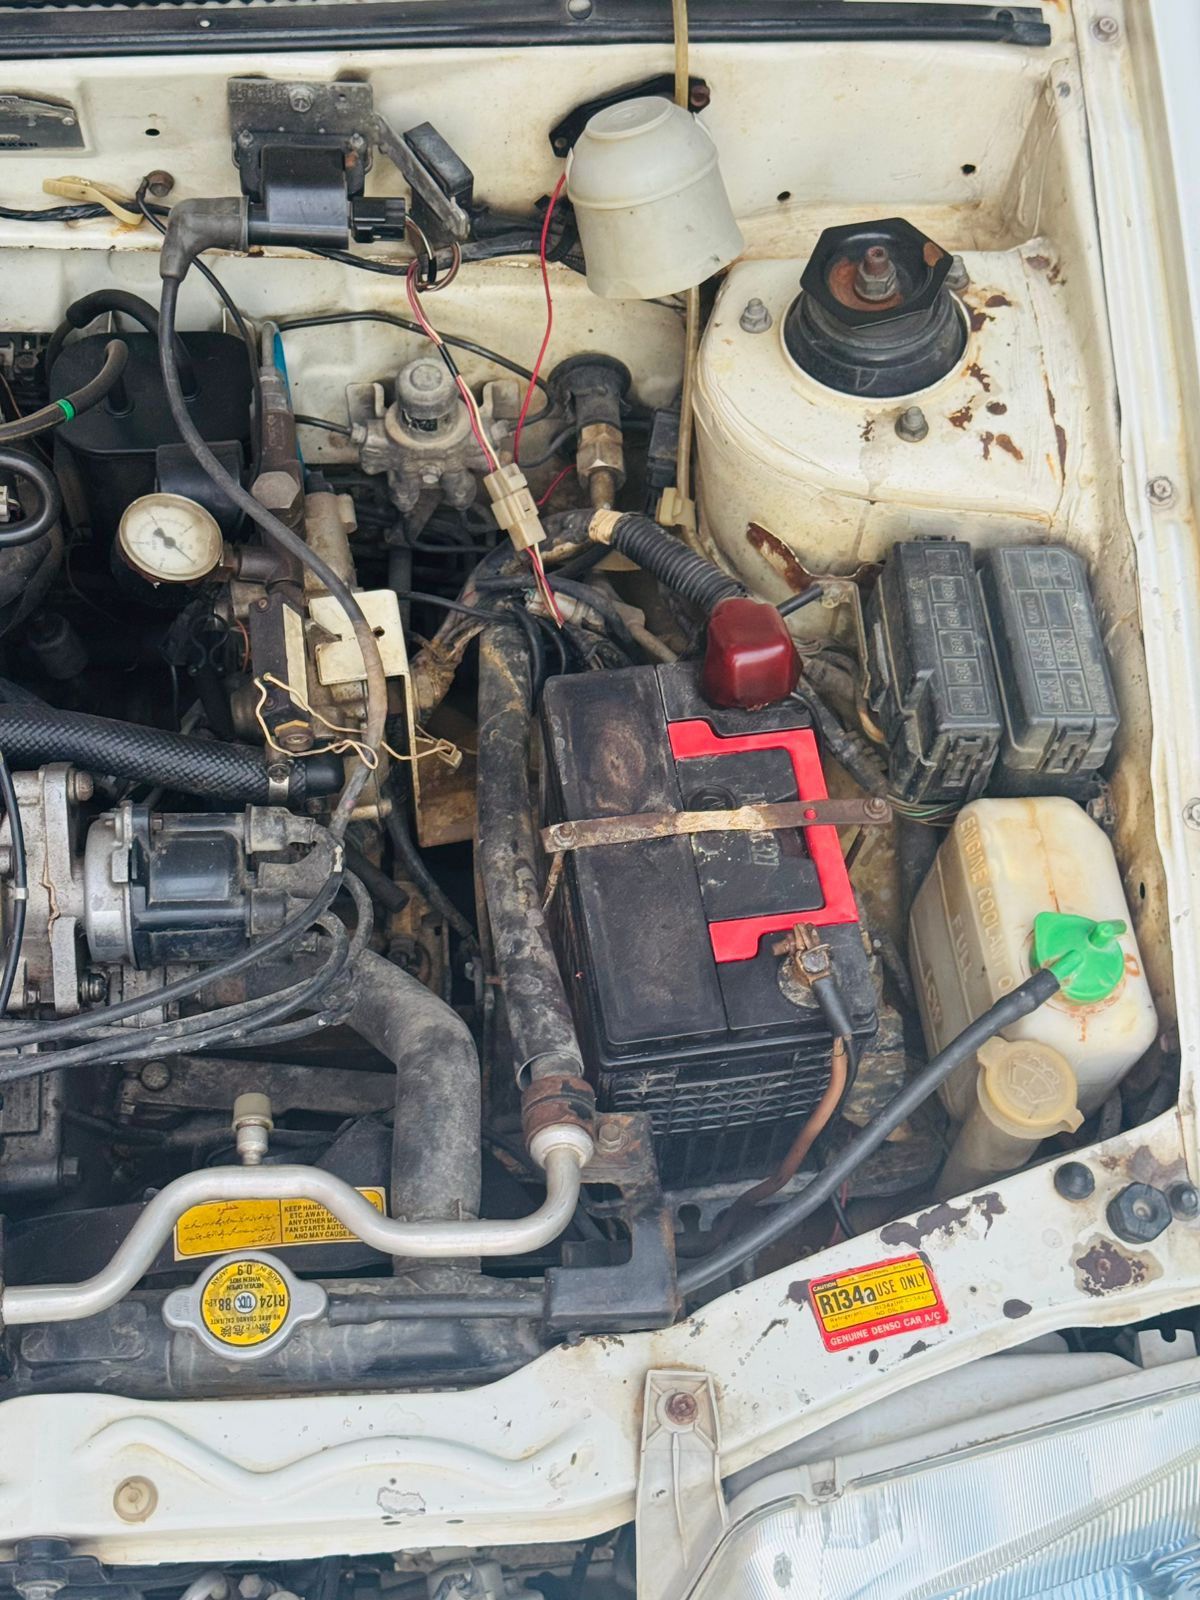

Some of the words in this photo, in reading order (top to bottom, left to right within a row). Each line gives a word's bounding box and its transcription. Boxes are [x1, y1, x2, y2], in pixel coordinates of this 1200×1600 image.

[960, 816, 989, 883] ENGINE
[976, 888, 1009, 968] COOLANT
[952, 914, 974, 982] FULL
[303, 1217, 326, 1225] OTHER
[325, 1230, 347, 1238] CAUSE
[211, 1268, 228, 1286] JAPAN
[237, 1264, 253, 1275] 0.9
[267, 1268, 282, 1286] MADE
[812, 1282, 837, 1292] CAUTION
[818, 1285, 877, 1315] R134a
[875, 1279, 897, 1297] USE
[900, 1272, 926, 1291] ONLY
[218, 1297, 231, 1311] 88
[260, 1294, 286, 1308] R124
[830, 1329, 869, 1346] GENUINE
[872, 1321, 901, 1335] DENSO
[903, 1316, 922, 1327] CAR
[925, 1311, 942, 1323] A/C
